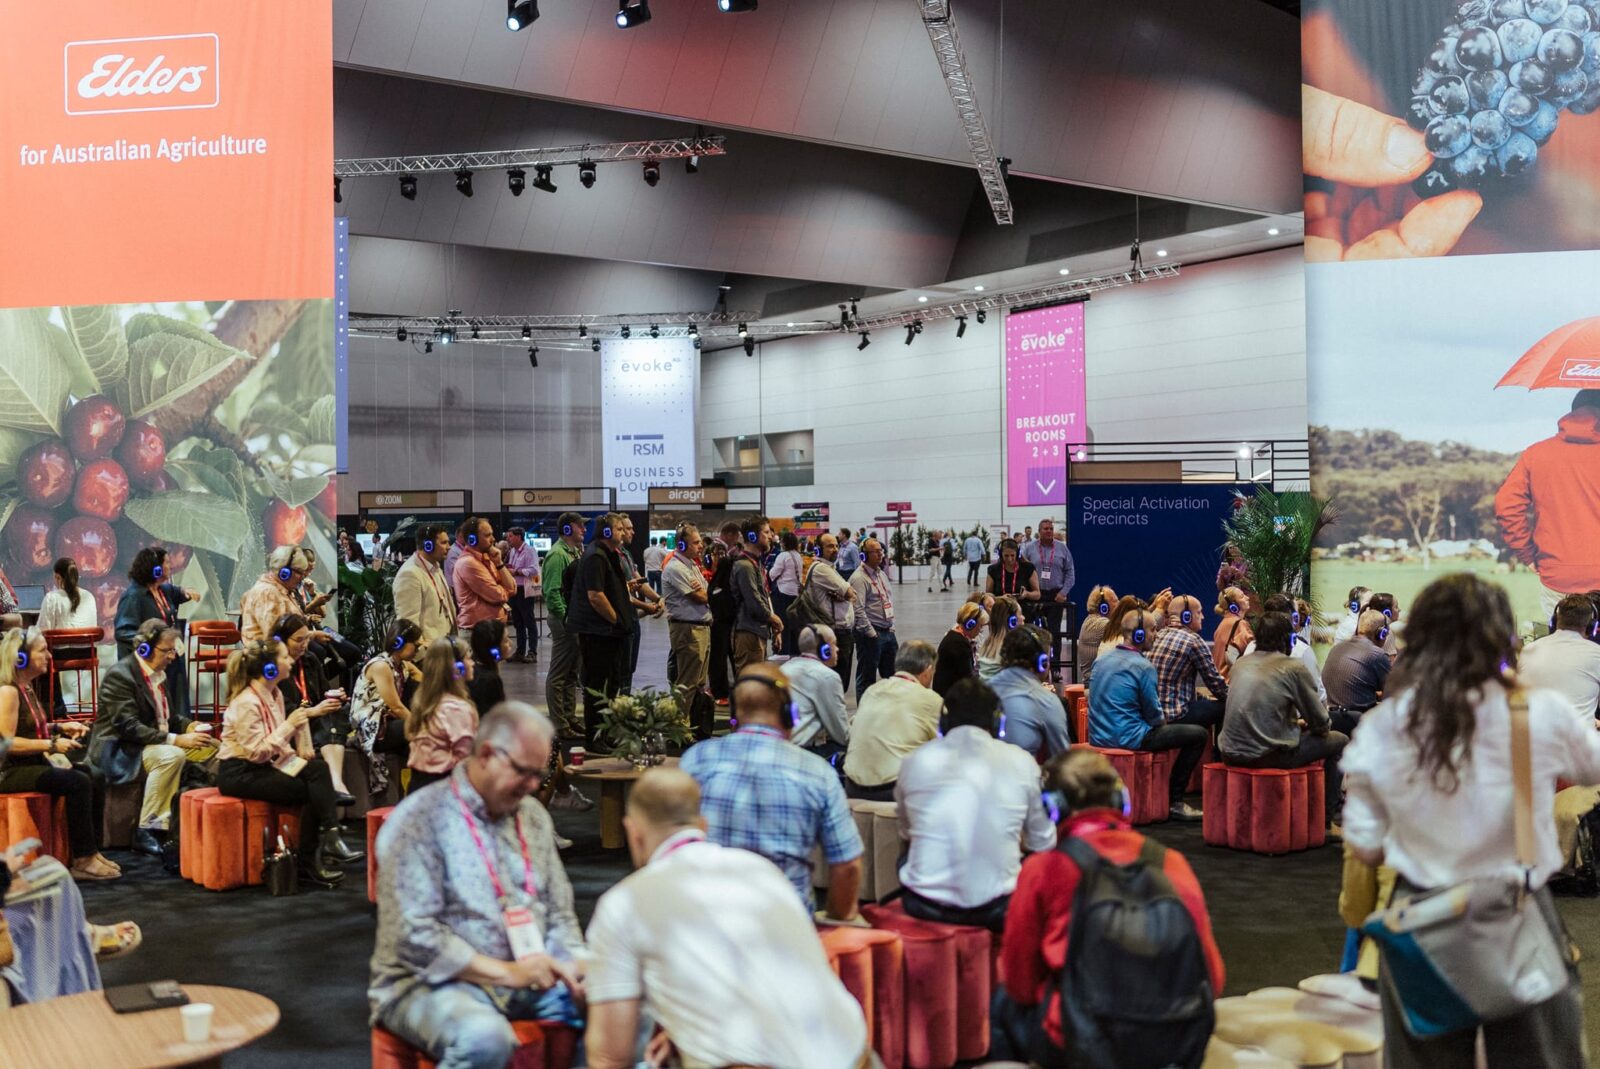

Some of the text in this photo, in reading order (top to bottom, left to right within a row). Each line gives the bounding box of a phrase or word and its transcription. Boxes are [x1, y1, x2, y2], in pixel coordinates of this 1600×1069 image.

[76, 54, 207, 98] Elders
[20, 134, 267, 165] for Australian Agriculture
[1016, 413, 1076, 429] BREAKOUT
[1025, 429, 1066, 443] ROOMS
[633, 444, 664, 455] RSM
[1032, 447, 1038, 457] 2
[1053, 445, 1059, 457] 3
[614, 466, 684, 478] BUSINESS
[668, 489, 705, 501] airagri
[1083, 496, 1210, 512] Special Activation
[1083, 511, 1149, 526] Precincts
